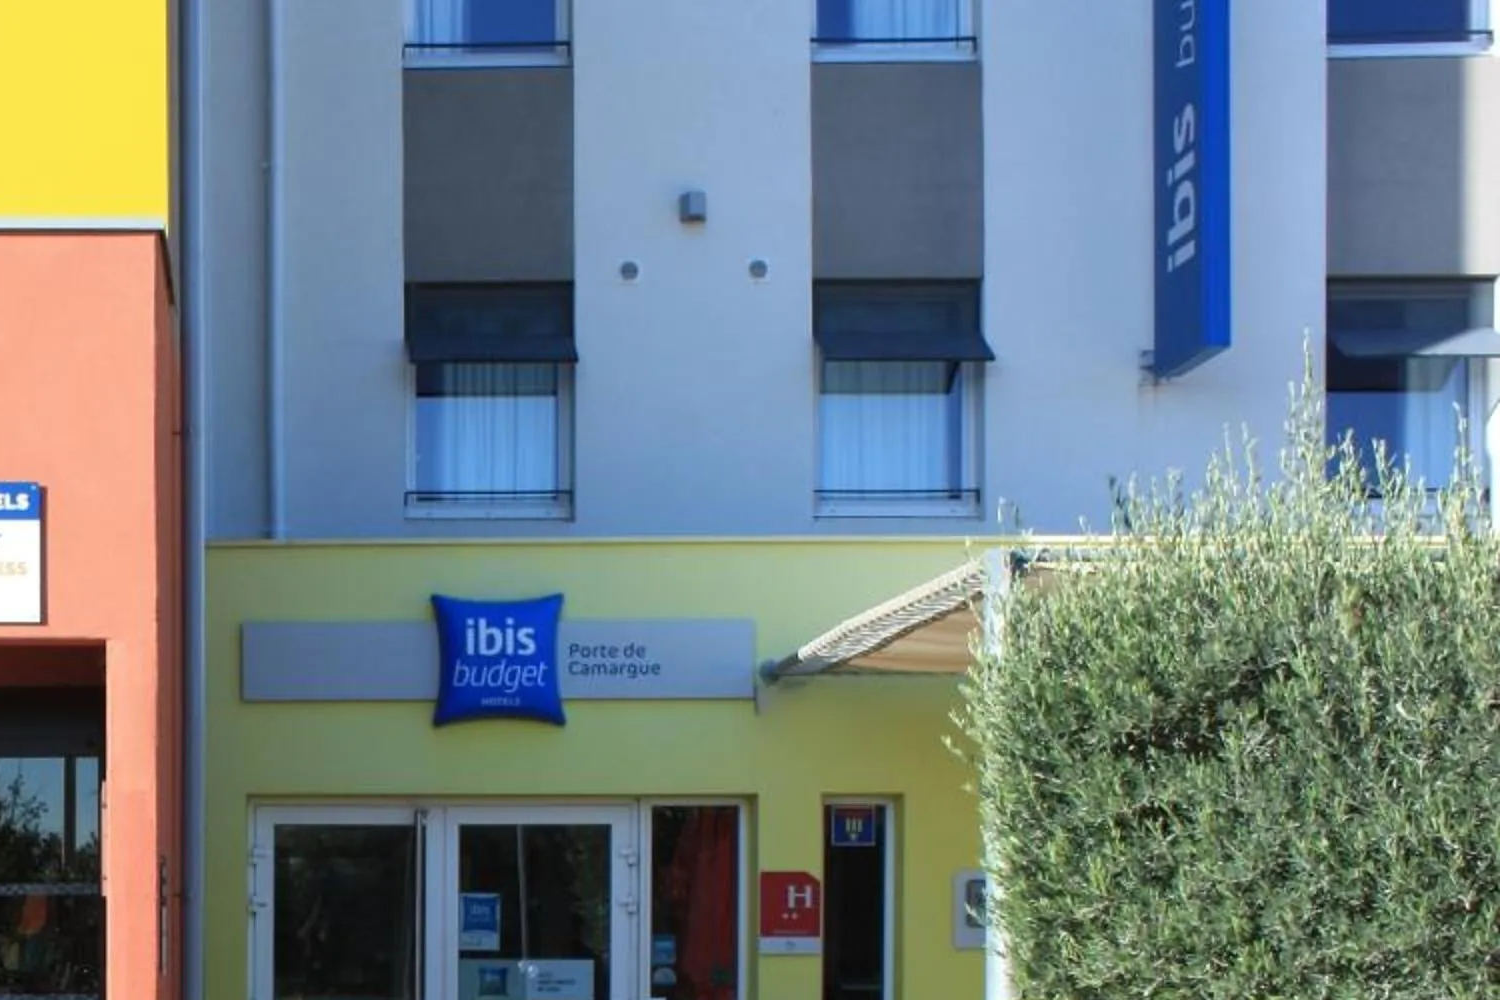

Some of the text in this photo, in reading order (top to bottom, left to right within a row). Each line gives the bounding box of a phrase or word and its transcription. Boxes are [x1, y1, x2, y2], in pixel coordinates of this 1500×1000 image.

[1167, 103, 1196, 272] ibis
[465, 617, 537, 656] ibis
[568, 642, 647, 659] Porte de
[452, 658, 549, 693] budget
[568, 661, 661, 679] Camargue
[787, 885, 813, 909] H
